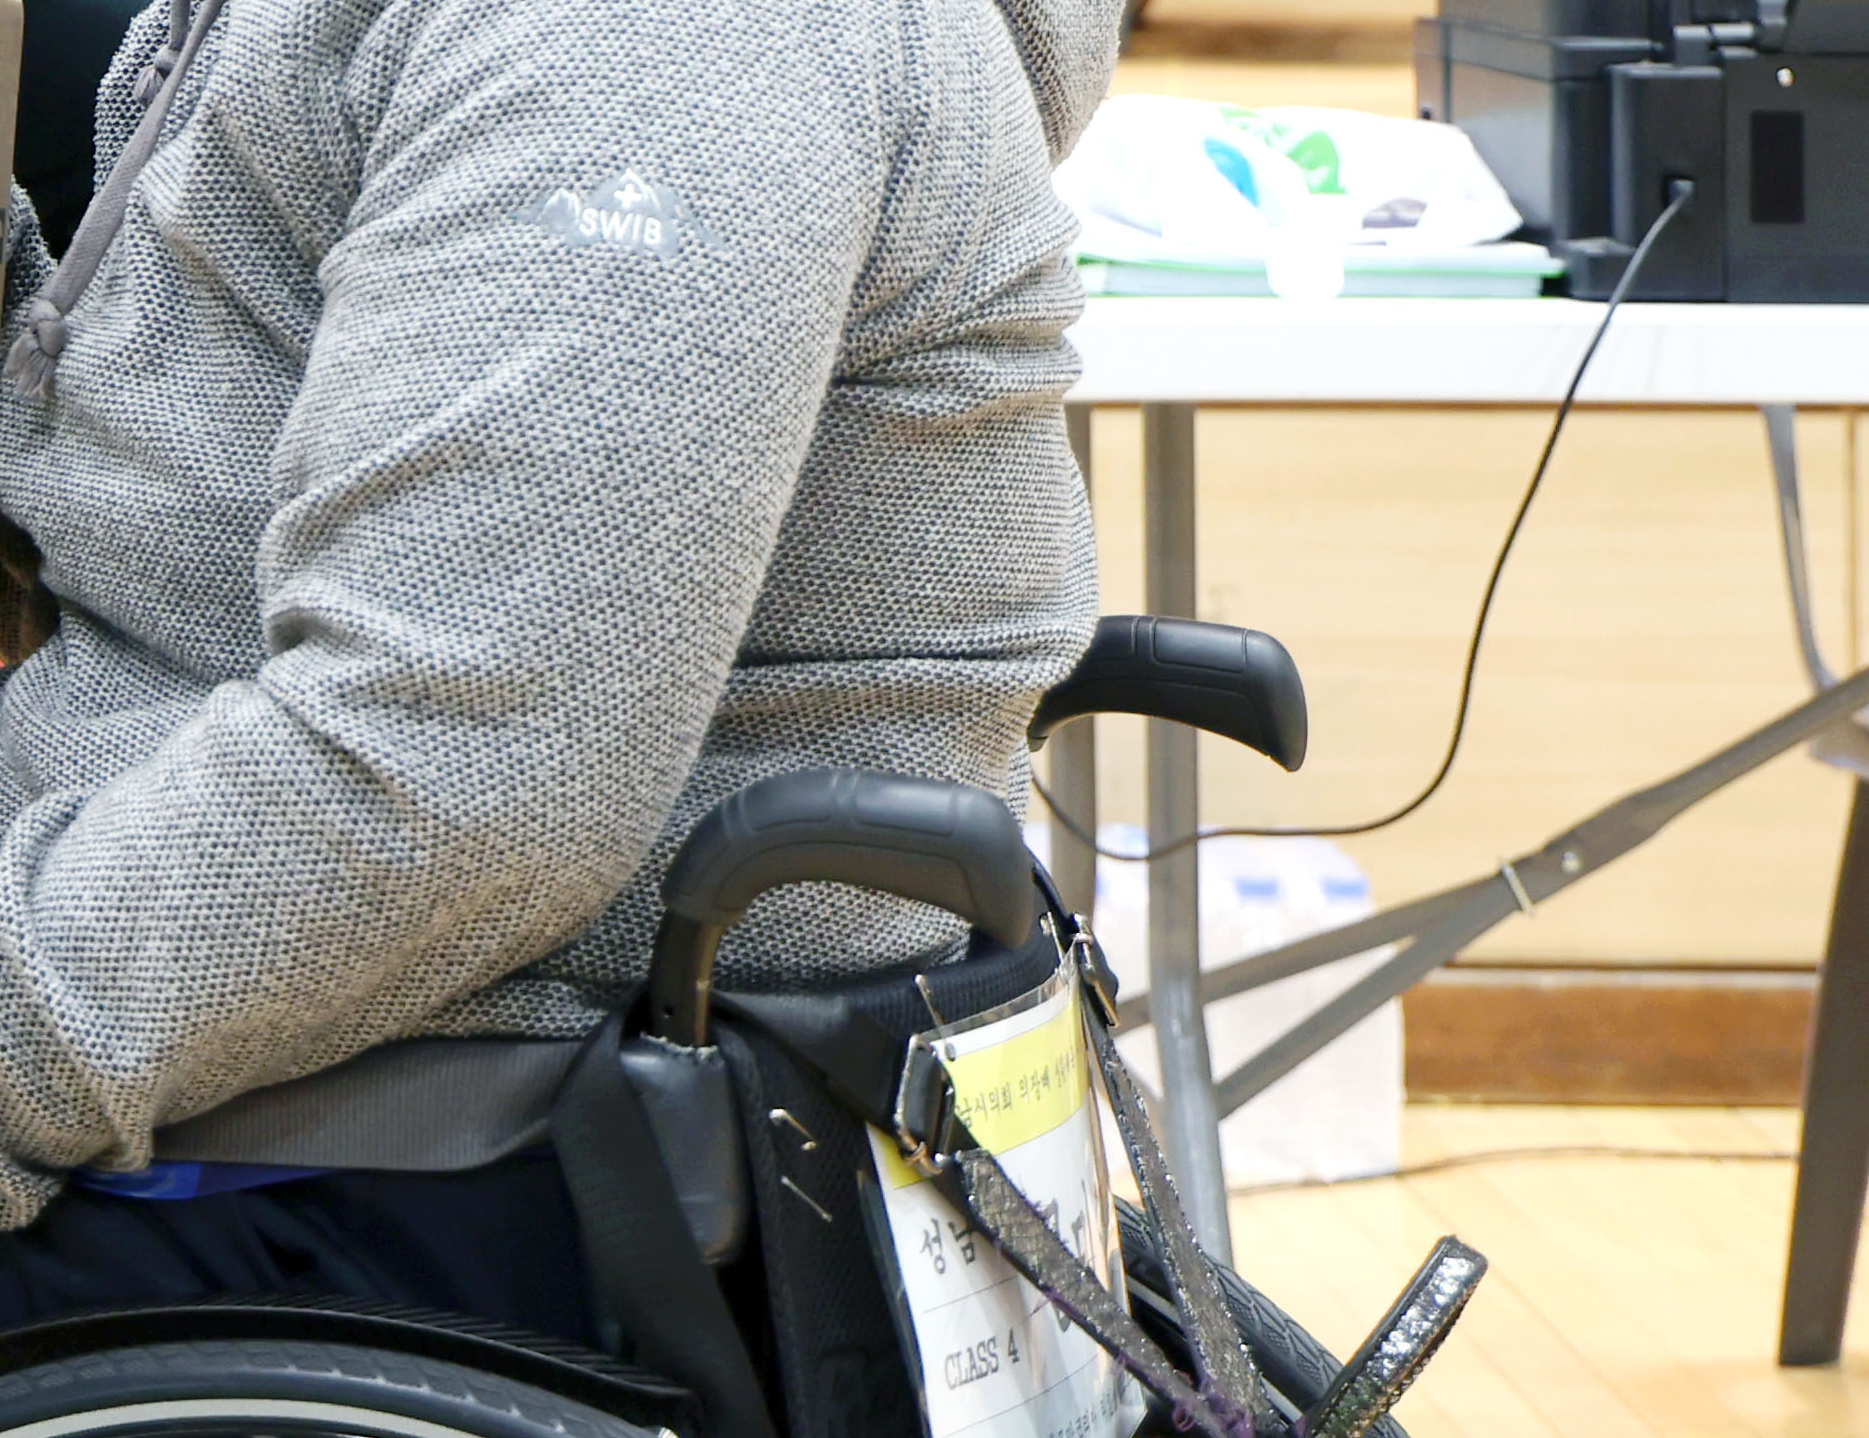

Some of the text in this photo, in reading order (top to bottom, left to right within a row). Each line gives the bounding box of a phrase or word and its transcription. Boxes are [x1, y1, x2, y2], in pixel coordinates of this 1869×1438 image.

[954, 1081, 1014, 1129] 남시의회
[944, 1328, 1020, 1391] CLASS 4
